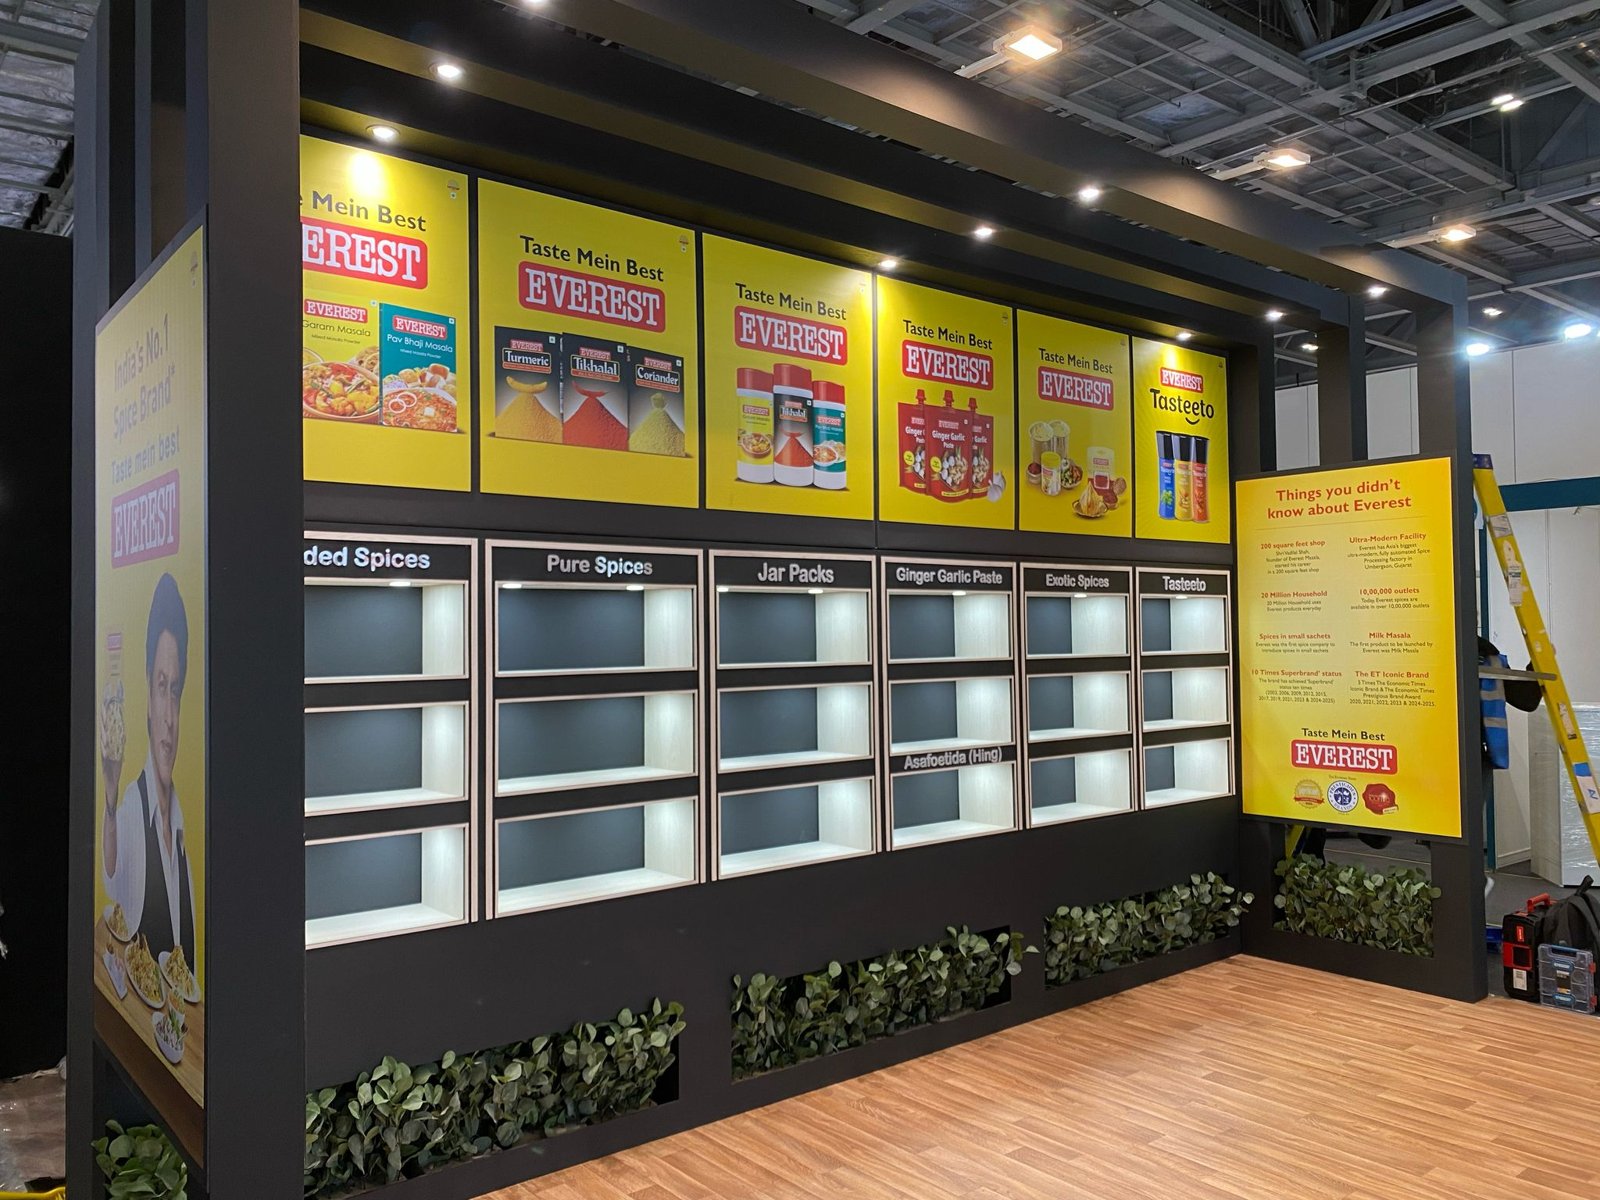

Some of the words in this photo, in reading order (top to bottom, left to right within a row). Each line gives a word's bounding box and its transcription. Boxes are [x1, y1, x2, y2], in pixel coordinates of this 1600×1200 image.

[313, 191, 368, 219] Mein
[378, 205, 426, 232] Best
[520, 235, 570, 262] Taste
[578, 248, 620, 272] Mein
[627, 260, 664, 281] Best
[525, 268, 660, 326] EVEREST
[735, 283, 774, 305] Taste
[780, 293, 812, 313] Mein
[818, 301, 846, 320] Best
[306, 301, 365, 321] EVEREST
[303, 320, 334, 331] Garam
[338, 326, 370, 336] Masala
[395, 318, 446, 338] EVEREST
[740, 312, 843, 359] EVEREST
[903, 320, 934, 338] Taste
[938, 327, 965, 344] Mein
[969, 334, 992, 349] Best
[387, 334, 402, 342] Pav
[405, 337, 423, 348] Bhaji
[425, 341, 452, 352] Masala
[511, 340, 543, 351] EVEREST
[114, 340, 143, 392] India's
[505, 351, 548, 366] Turmeric
[573, 357, 617, 375] Tikhalal
[906, 345, 990, 385] EVEREST
[1039, 348, 1064, 364] Taste
[1068, 354, 1090, 369] Mein
[1093, 360, 1112, 374] Best
[637, 367, 678, 385] Coriander
[1162, 369, 1202, 391] EVEREST
[1041, 371, 1111, 406] EVEREST
[1150, 388, 1214, 418] Tasteeto
[114, 405, 137, 444] Spice
[932, 430, 949, 441] Ginger
[951, 433, 965, 441] Garlic
[112, 456, 132, 484] Taste
[135, 439, 155, 474] mein
[159, 424, 180, 461] best
[1276, 489, 1321, 501] Things
[1326, 487, 1351, 500] you
[1357, 479, 1400, 494] didn't
[1268, 508, 1303, 519] know
[1308, 502, 1349, 516] about
[1354, 497, 1411, 512] Everest
[114, 482, 176, 558] EVEREST
[303, 546, 347, 568] ded
[353, 547, 431, 572] Spices
[547, 554, 590, 574] Pure
[595, 556, 653, 578] Spices
[758, 562, 786, 582] Jar
[789, 563, 834, 584] Packs
[896, 567, 936, 585] Ginger
[938, 568, 971, 584] Garlic
[972, 569, 1003, 584] Paste
[1046, 574, 1076, 587] Exotic
[1078, 574, 1109, 590] Spices
[1162, 576, 1206, 591] Tasteeto
[1302, 728, 1328, 738] Taste
[1332, 730, 1357, 739] Mein
[1361, 731, 1385, 741] Best
[904, 751, 966, 770] Asafoetida
[969, 747, 1002, 765] (Hing)
[1295, 743, 1392, 770] EVEREST
